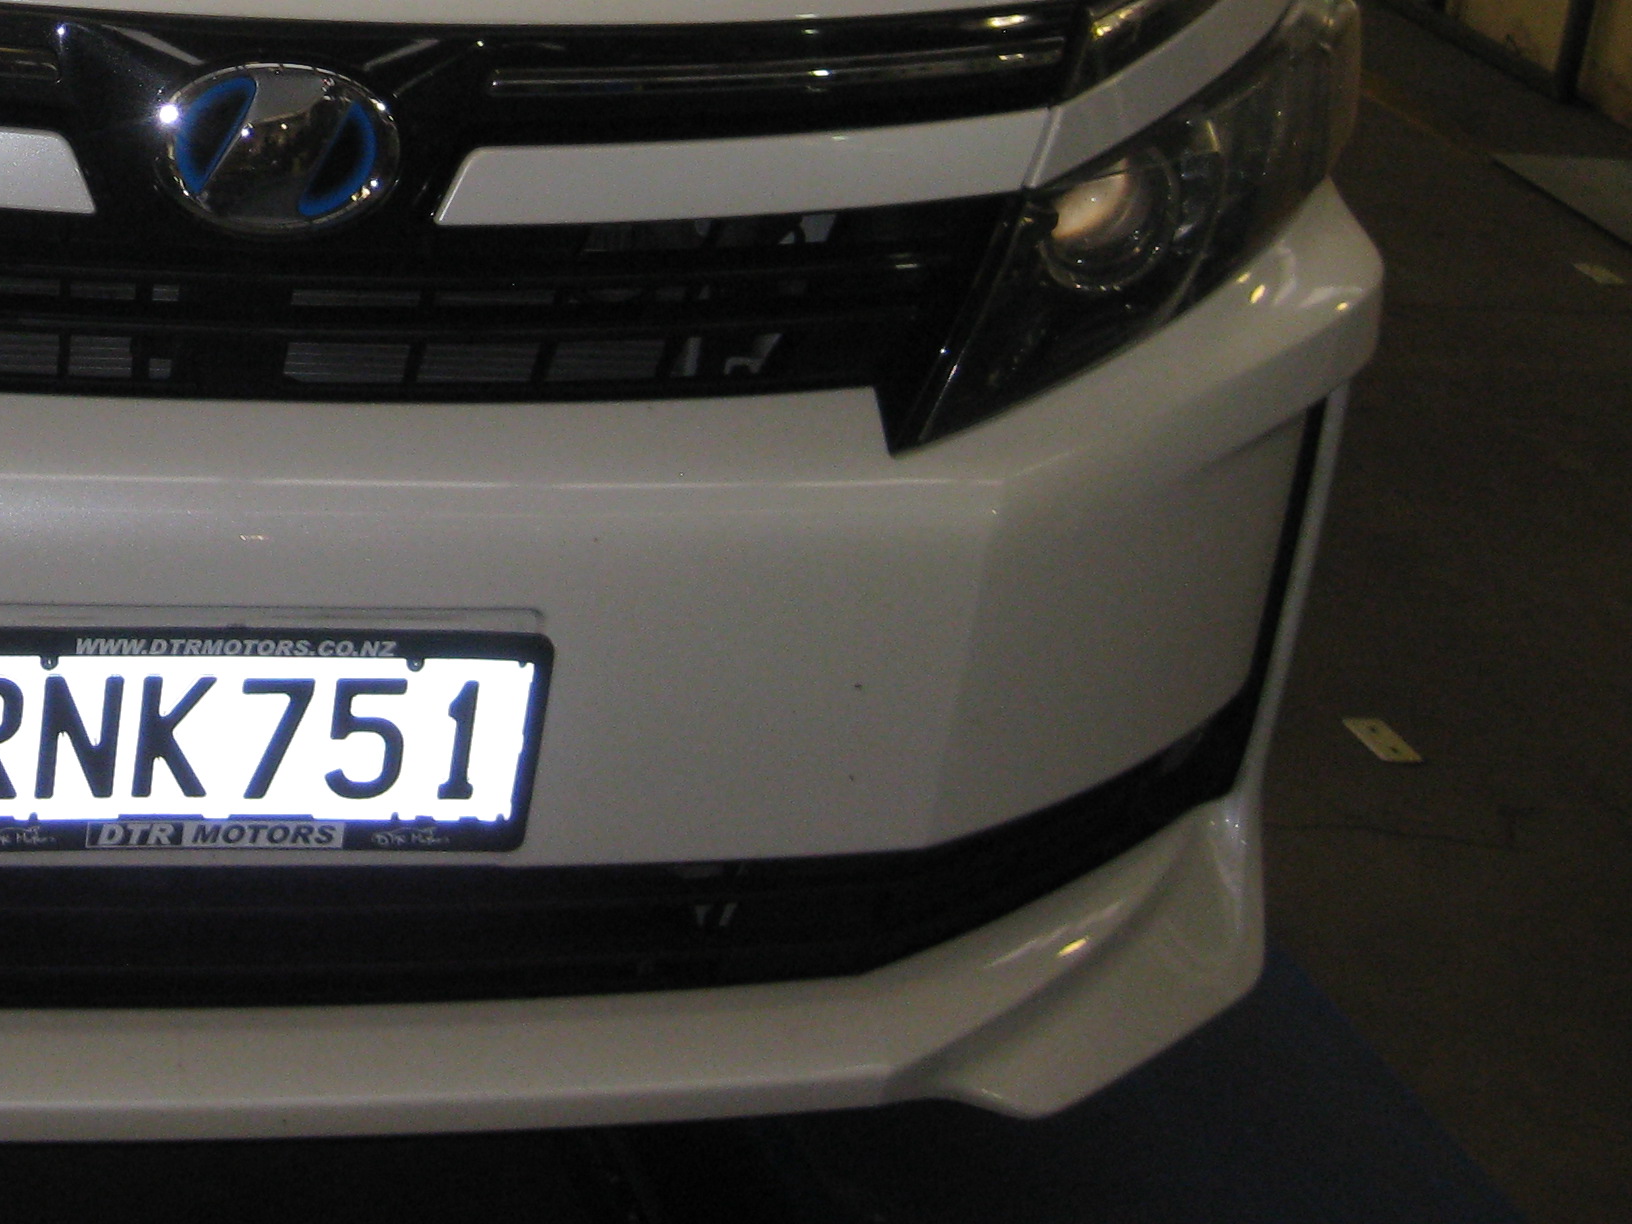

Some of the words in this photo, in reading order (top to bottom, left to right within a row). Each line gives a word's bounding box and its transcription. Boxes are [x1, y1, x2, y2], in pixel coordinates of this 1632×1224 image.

[75, 637, 397, 657] WWW.DTRMOTORS.CO.NZ
[97, 823, 175, 846] DTR
[191, 824, 335, 846] MOTORS
